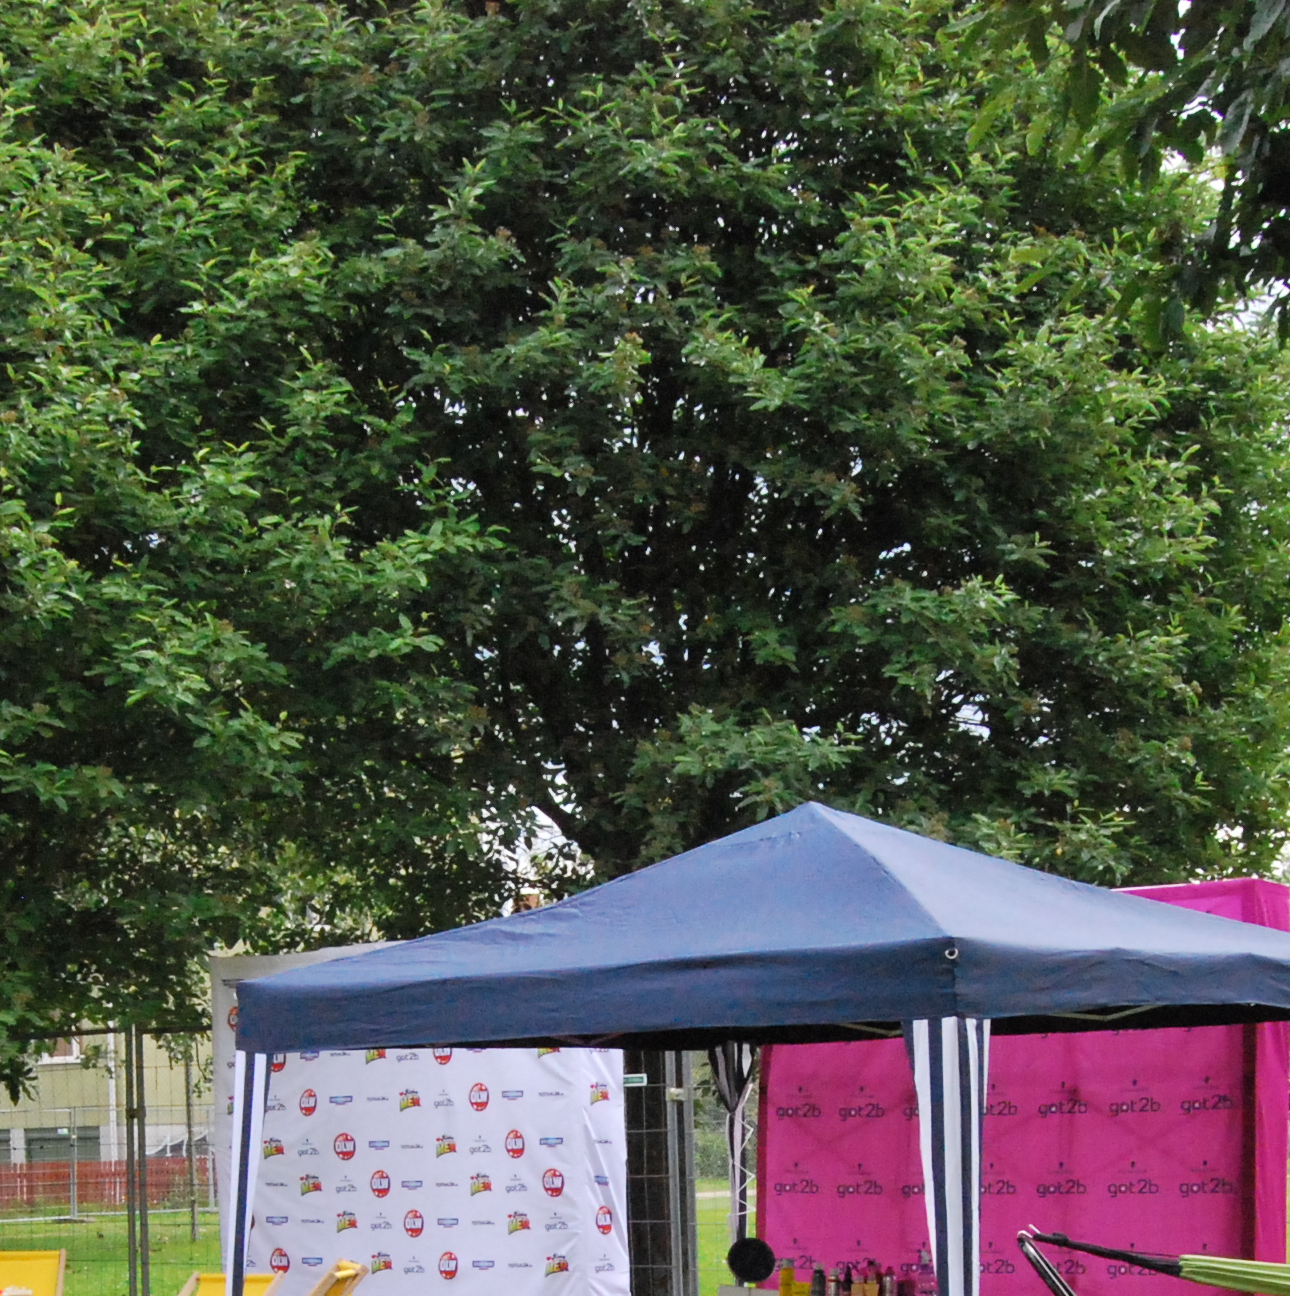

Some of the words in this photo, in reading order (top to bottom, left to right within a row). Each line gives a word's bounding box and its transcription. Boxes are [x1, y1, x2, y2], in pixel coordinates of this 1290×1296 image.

[777, 1104, 821, 1120] got2b
[839, 1104, 884, 1120] got2b
[1039, 1100, 1087, 1117] got2b
[1110, 1098, 1160, 1117] got2b
[1181, 1094, 1233, 1114] got2b
[774, 1180, 819, 1195] got2b
[837, 1181, 882, 1197] got2b
[981, 1180, 1016, 1194] ot2b
[1037, 1180, 1086, 1197] got2b
[1108, 1180, 1158, 1197] got2b
[1179, 1178, 1233, 1197] got2b
[980, 1259, 1015, 1273] ot2b
